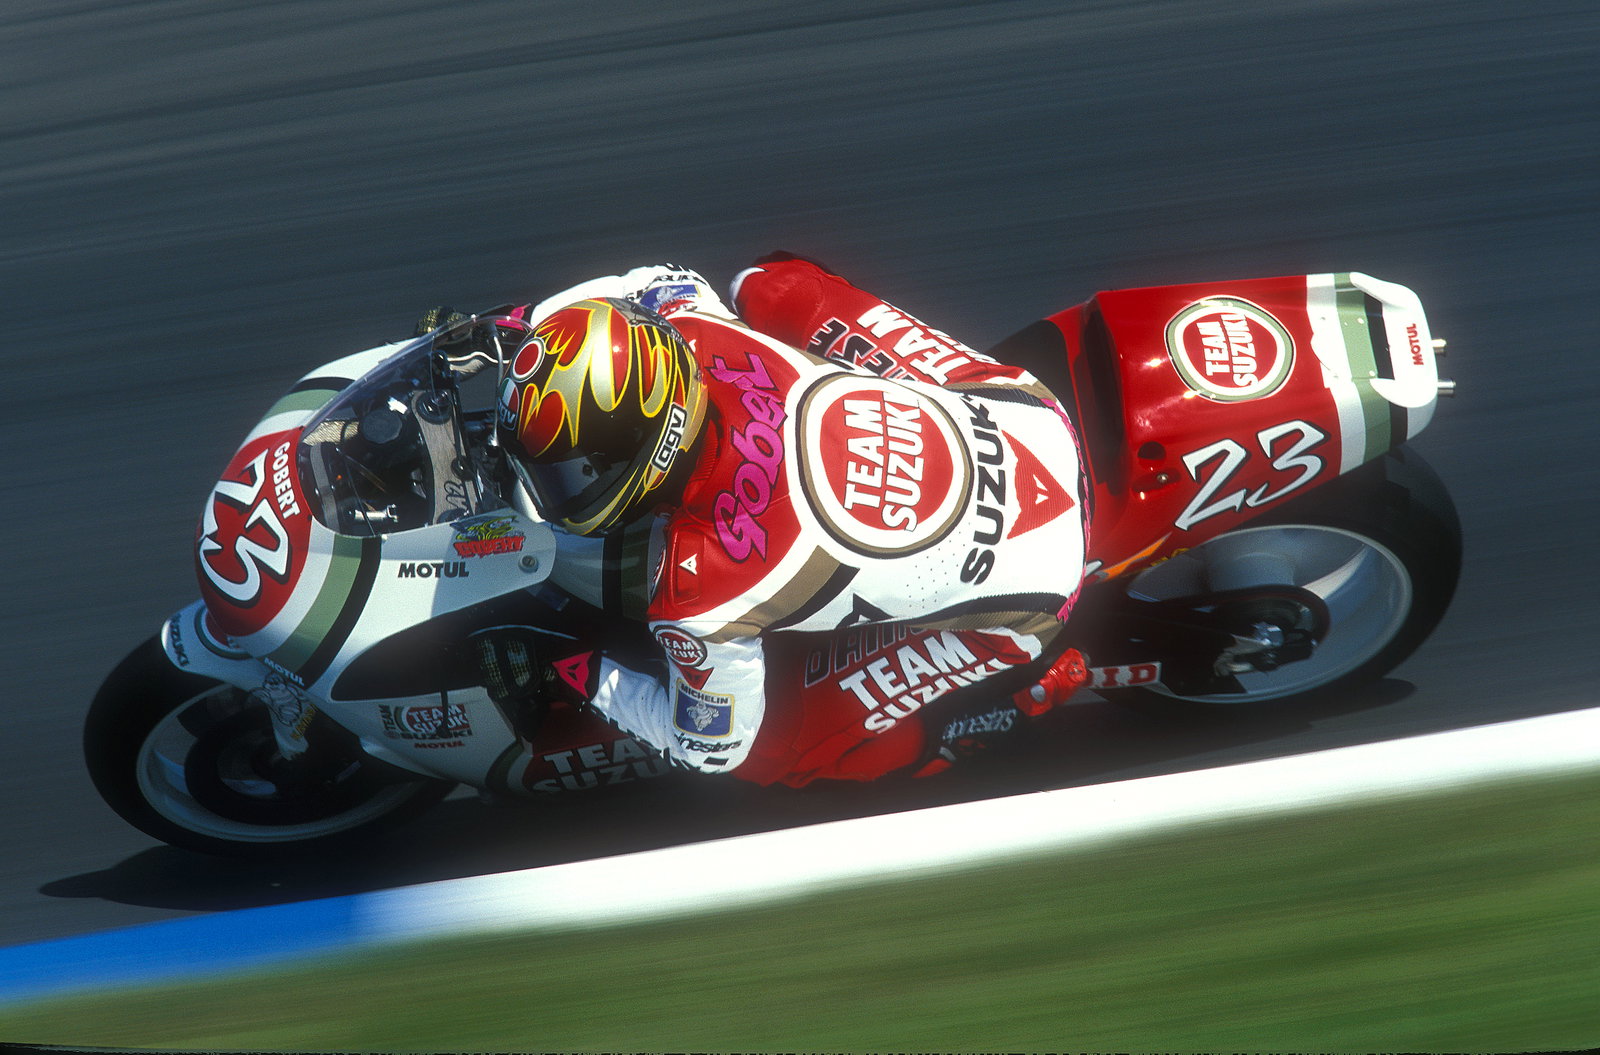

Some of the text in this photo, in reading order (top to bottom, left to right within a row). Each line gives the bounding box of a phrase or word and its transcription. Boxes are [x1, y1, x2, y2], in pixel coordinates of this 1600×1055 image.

[856, 304, 972, 386] TEAM
[1197, 320, 1231, 377] TEAM
[1221, 312, 1258, 387] SUZUKI
[1406, 323, 1424, 366] MOTUL
[655, 411, 685, 467] agv
[843, 399, 884, 510] TEAM
[881, 390, 924, 533] SUZUKI
[271, 441, 300, 520] GOBERT
[1174, 420, 1325, 531] 23
[199, 448, 290, 602] 23
[398, 562, 470, 579] MOTUL
[264, 657, 305, 687] MOTUL
[678, 683, 730, 705] MICHELIN
[839, 630, 979, 713] TEAM
[413, 741, 465, 750] MOTUL
[544, 737, 664, 776] TEA
